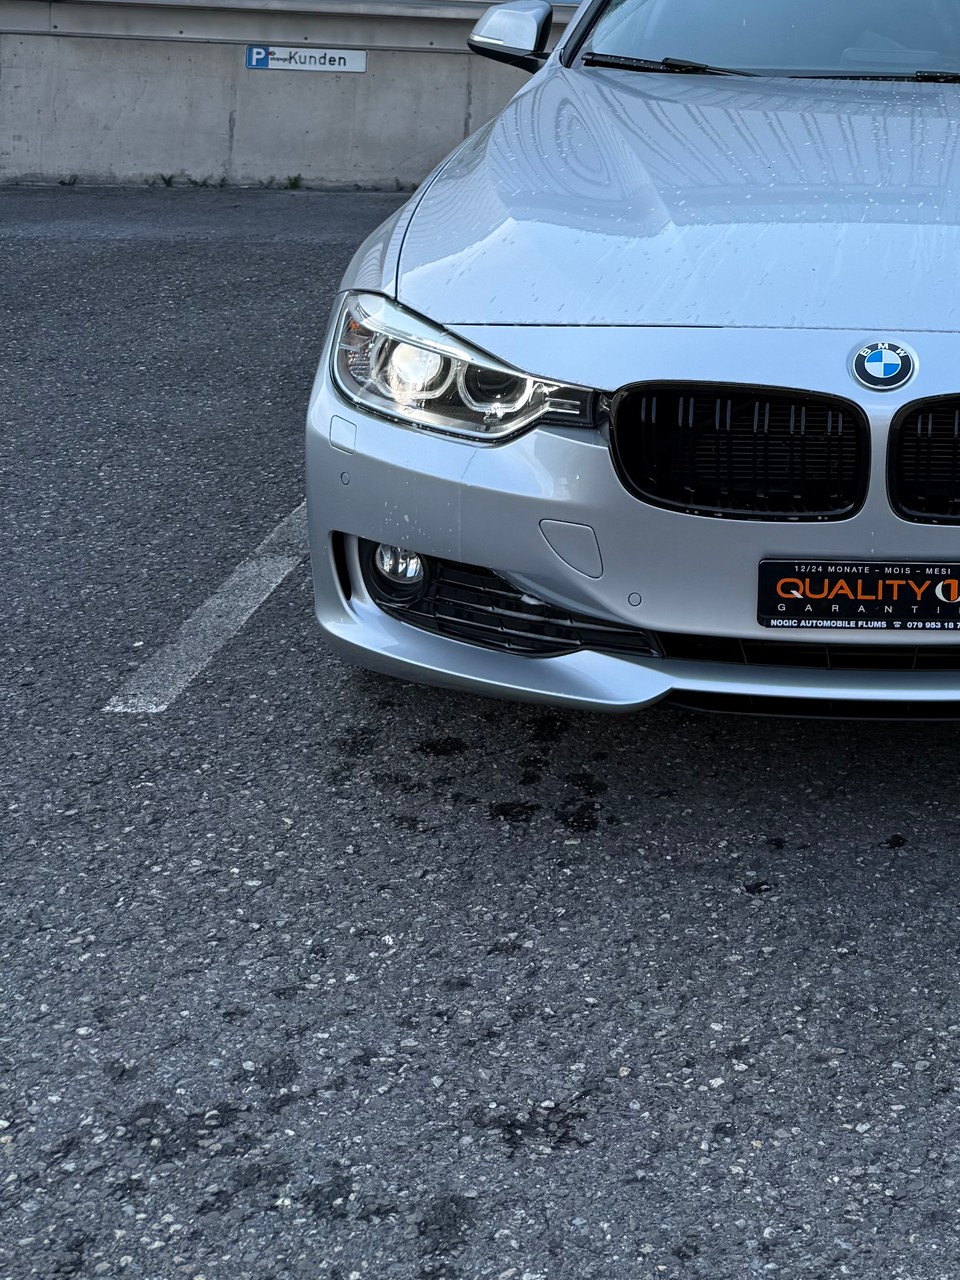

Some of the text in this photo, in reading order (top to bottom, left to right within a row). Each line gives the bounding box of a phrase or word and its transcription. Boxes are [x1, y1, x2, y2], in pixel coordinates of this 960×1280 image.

[252, 48, 265, 66] P
[289, 51, 347, 66] Kunden
[860, 342, 908, 357] BMW
[794, 565, 823, 573] 12/24
[925, 567, 951, 575] MESI
[776, 577, 932, 601] QUALITY
[770, 619, 798, 627] NOGIC
[800, 620, 856, 628] AUTOMOBILE
[858, 620, 887, 628] FLUMS
